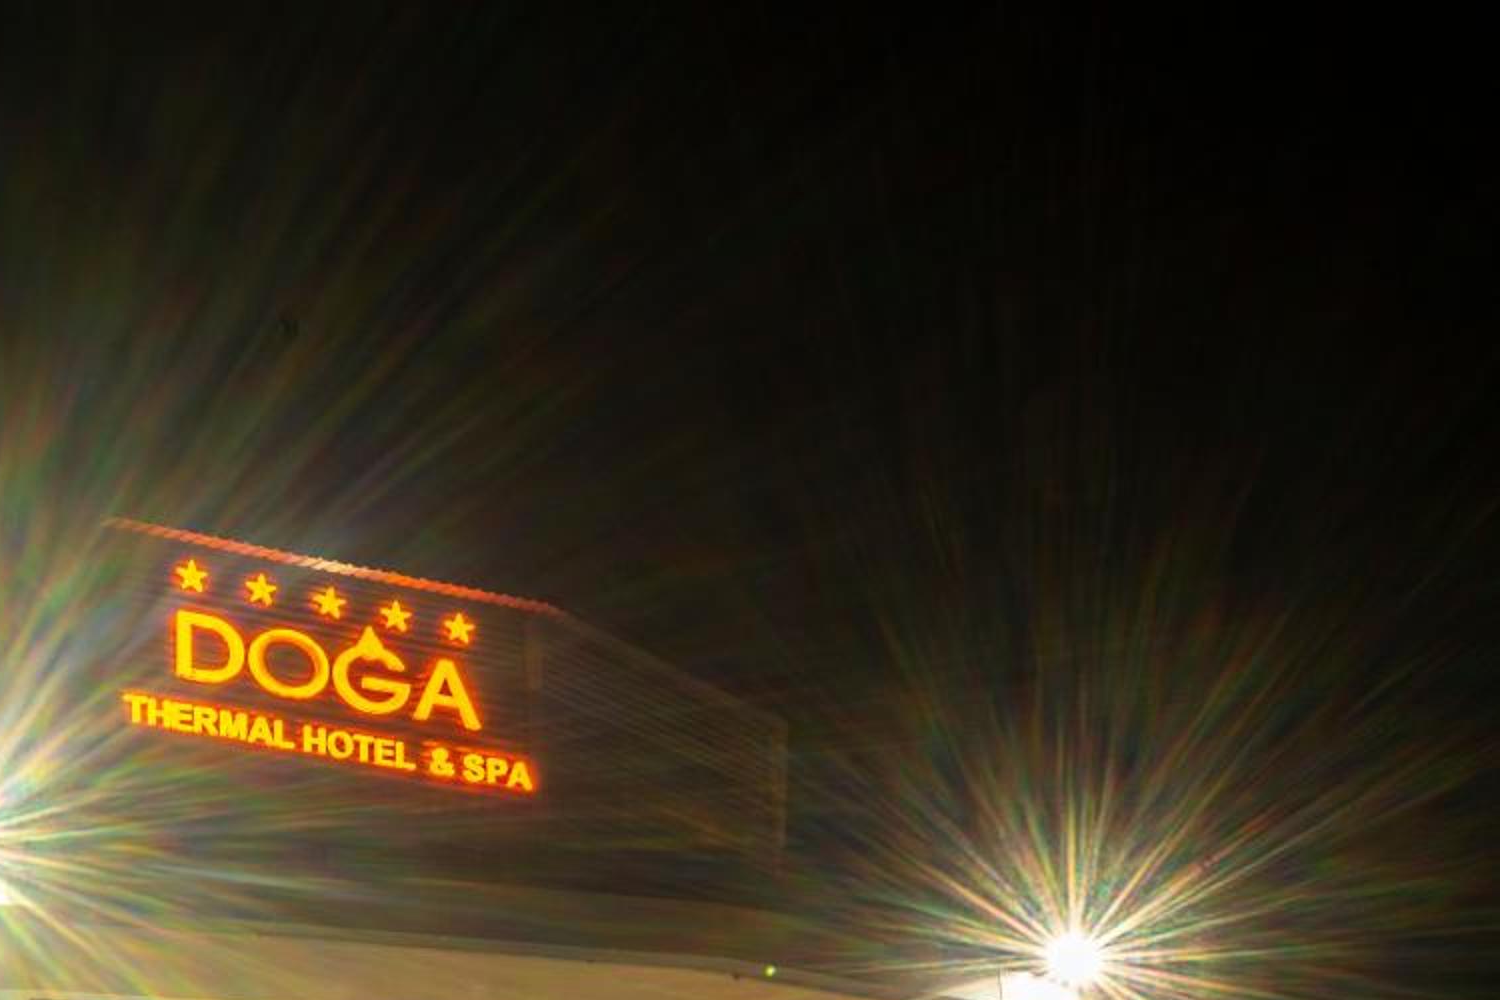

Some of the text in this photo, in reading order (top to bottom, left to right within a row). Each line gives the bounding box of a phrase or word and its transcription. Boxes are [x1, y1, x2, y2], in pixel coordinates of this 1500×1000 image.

[122, 692, 535, 791] THERMAL HOTEL & SPA
